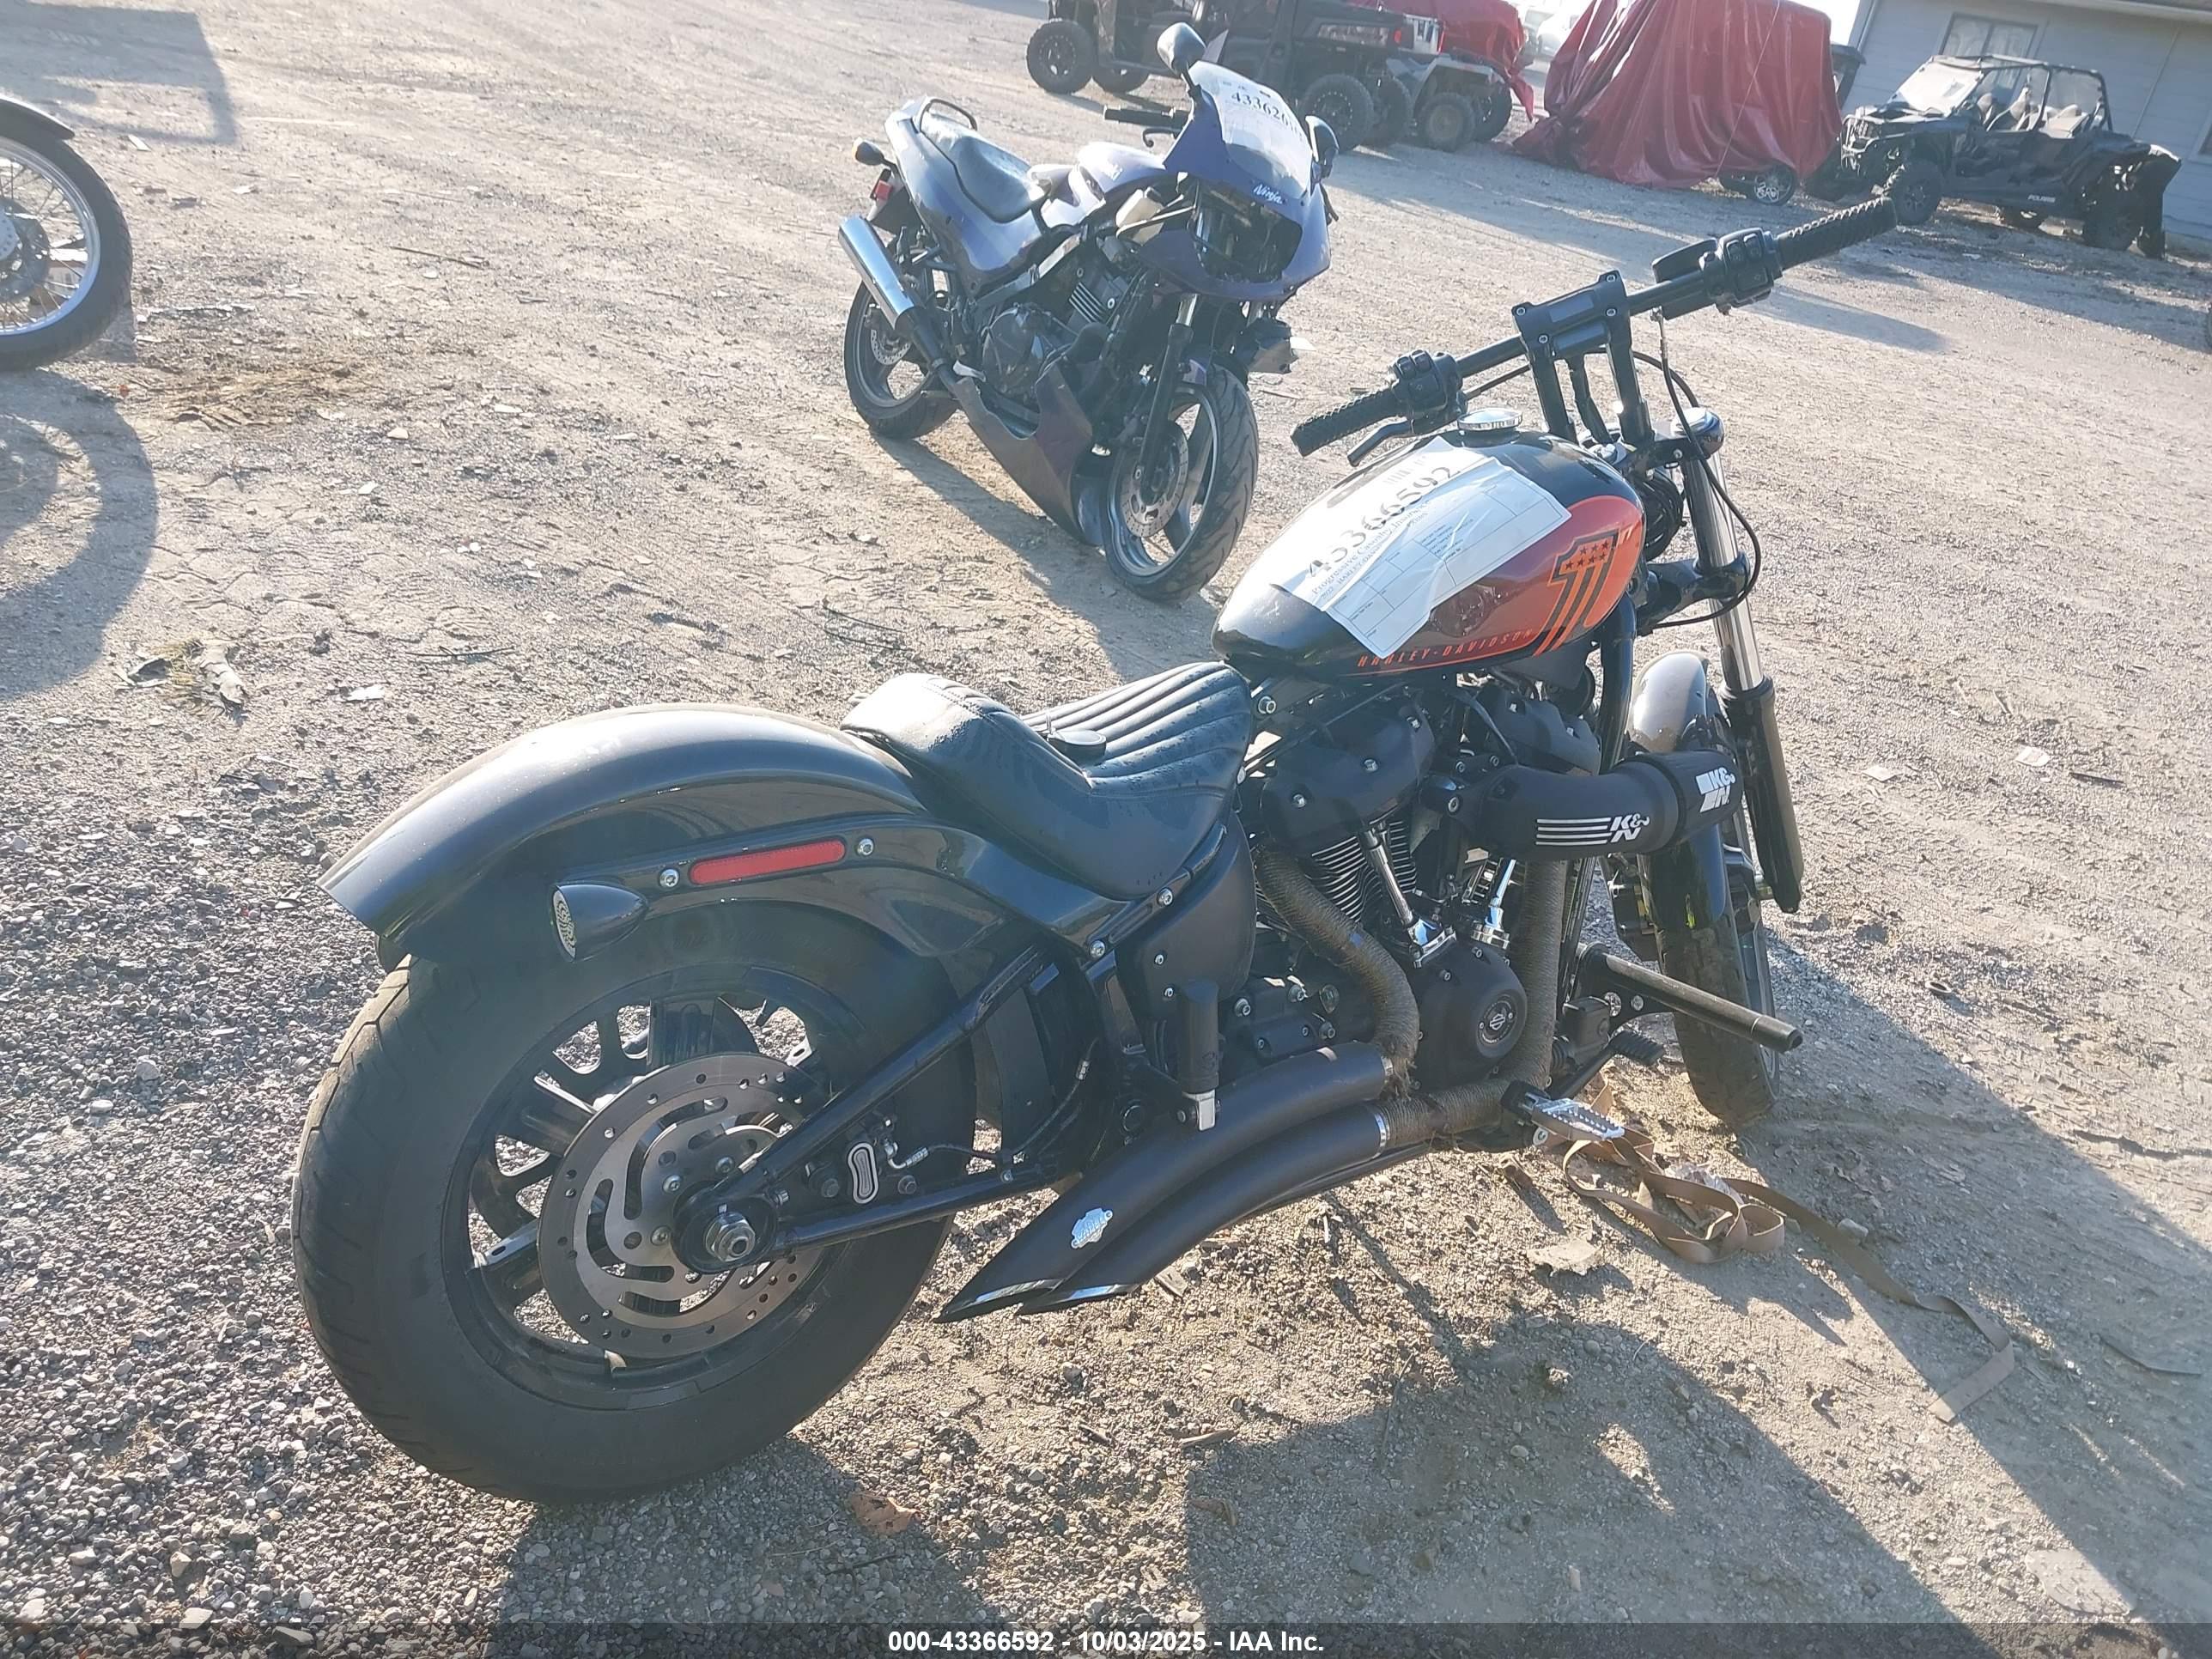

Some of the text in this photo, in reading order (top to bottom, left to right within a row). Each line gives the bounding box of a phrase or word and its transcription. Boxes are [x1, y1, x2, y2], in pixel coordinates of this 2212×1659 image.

[1312, 554, 1358, 594] Progressive
[1358, 628, 1533, 667] HARLEY-DAVIDSON
[1610, 813, 1650, 843] K&N
